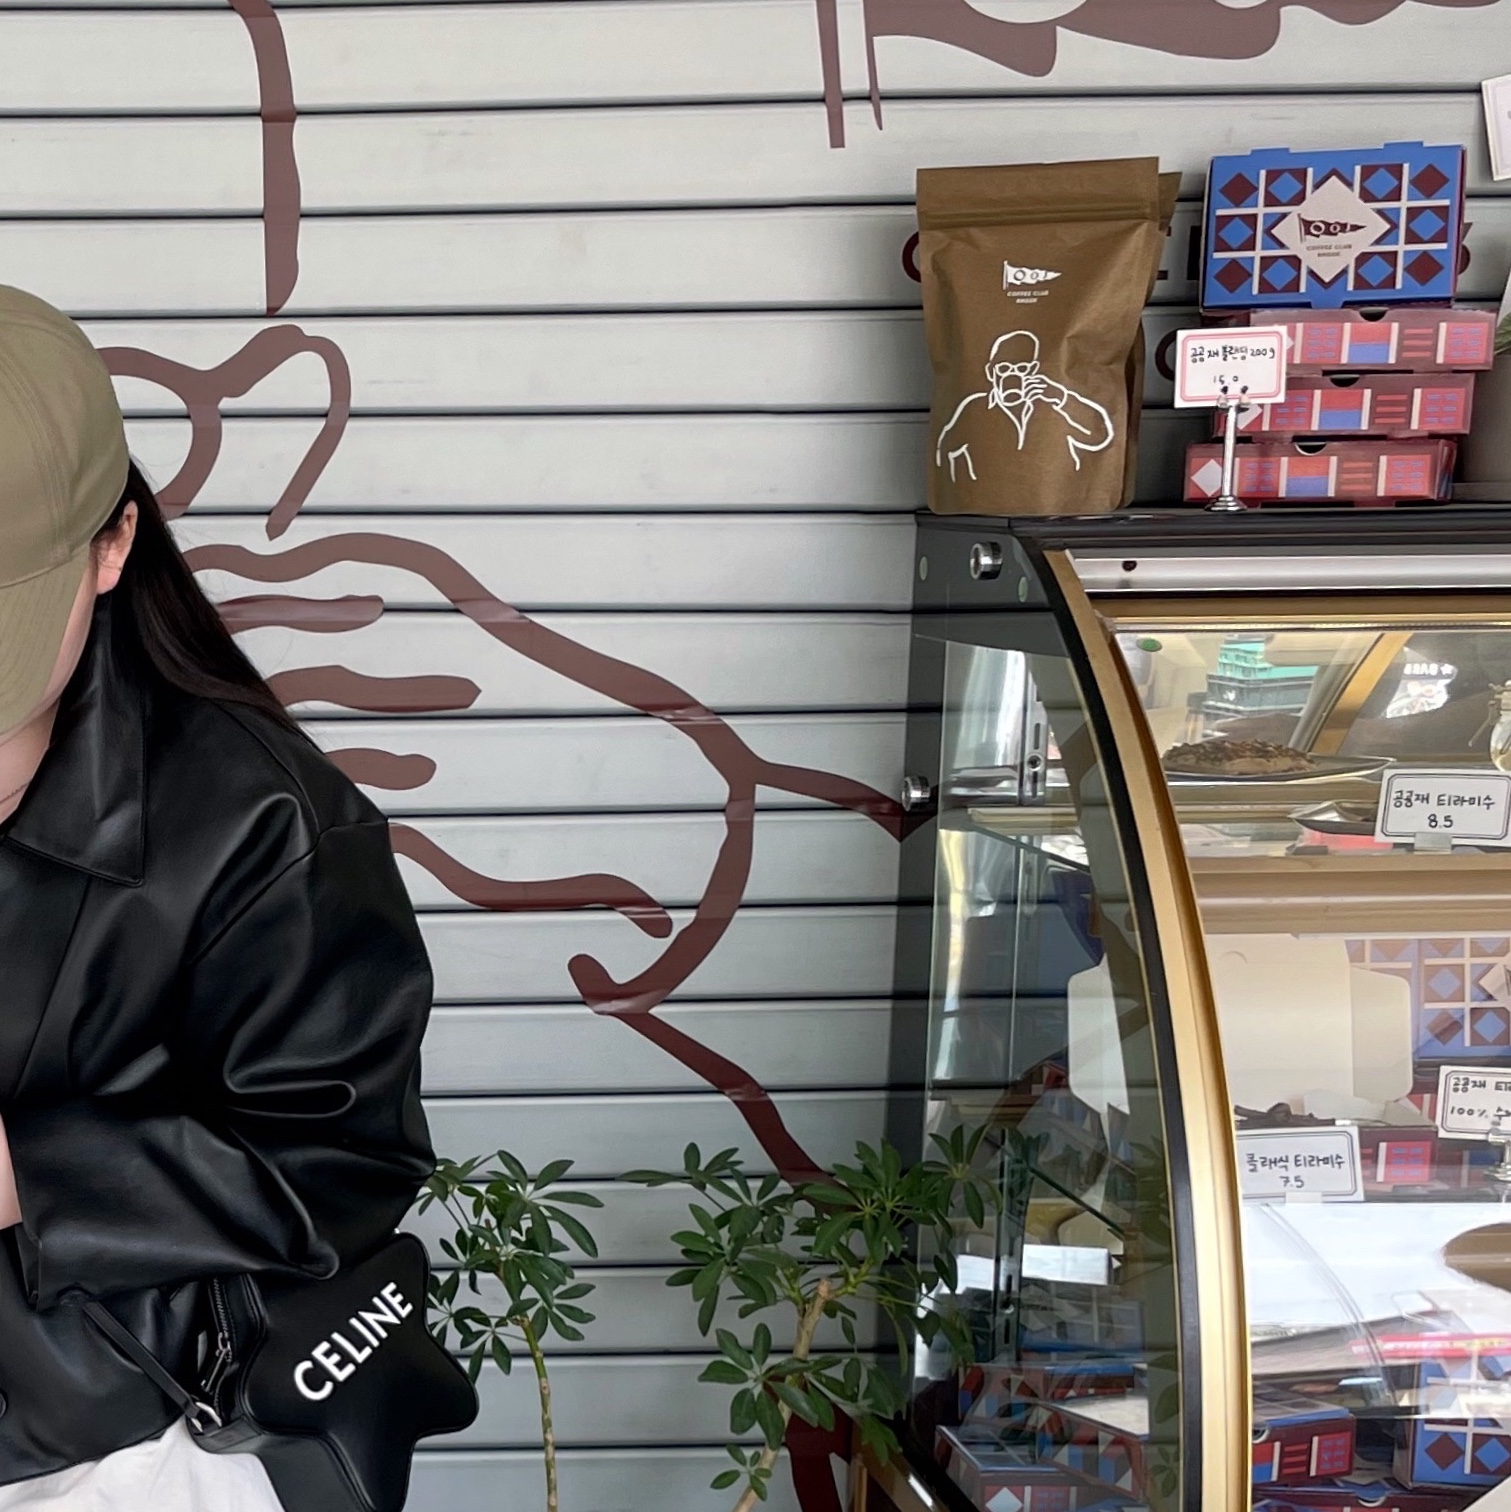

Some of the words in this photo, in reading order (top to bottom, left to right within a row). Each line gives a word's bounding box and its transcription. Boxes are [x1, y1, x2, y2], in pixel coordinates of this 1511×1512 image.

[1190, 346, 1219, 363] 공공재
[1249, 347, 1276, 360] 200g
[1393, 789, 1430, 808] 공공재
[1436, 793, 1496, 811] 티라미수
[1427, 813, 1454, 828] 8.5
[1452, 1077, 1487, 1093] 공공재
[1450, 1106, 1488, 1119] 100%
[1246, 1152, 1289, 1172] 클래식
[1294, 1153, 1345, 1169] 티라미수
[1279, 1175, 1305, 1188] 7.5
[293, 1281, 413, 1401] CELINE
